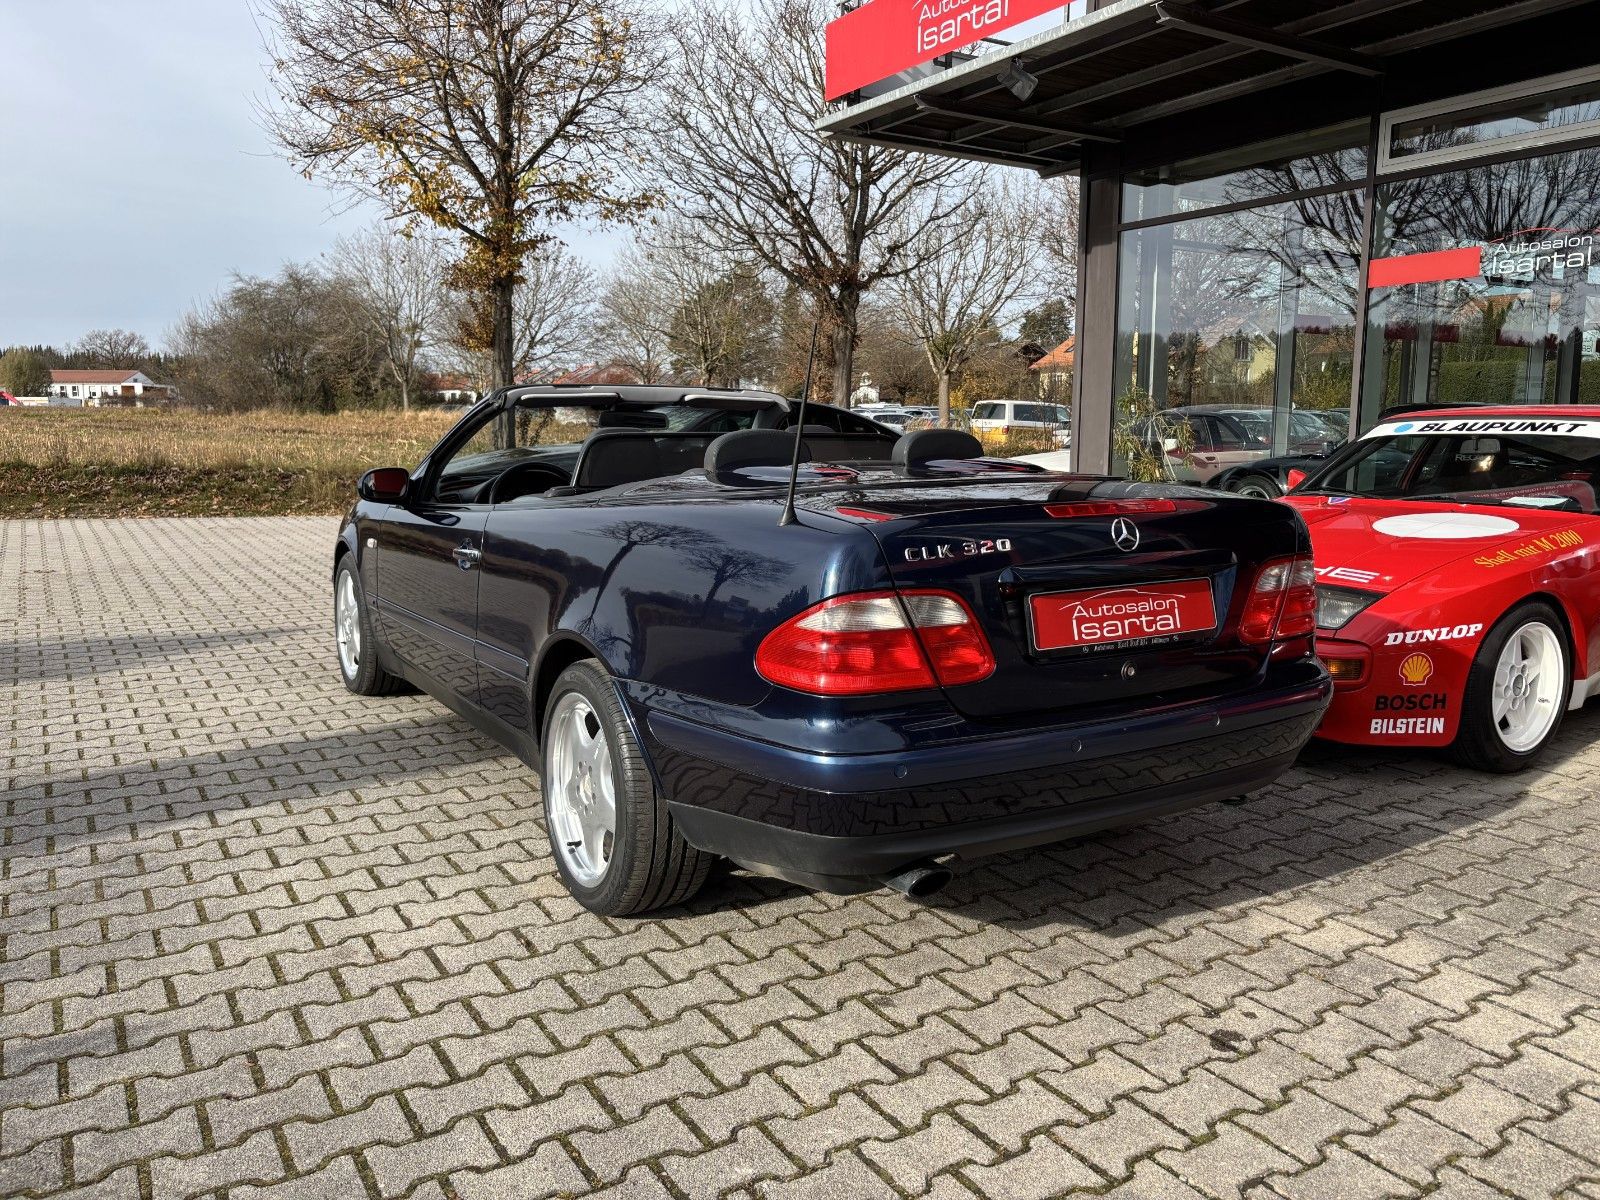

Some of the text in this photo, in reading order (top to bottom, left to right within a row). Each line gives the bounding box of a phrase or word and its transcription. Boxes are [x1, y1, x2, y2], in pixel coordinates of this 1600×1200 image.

[916, 0, 1009, 54] Isartal
[1494, 235, 1593, 255] Autosalon
[1491, 246, 1592, 275] Isartal
[1417, 421, 1588, 433] BLAUPUNKT
[904, 538, 1012, 562] CLK 320
[1473, 529, 1584, 568] Shell mit M 2000
[1072, 597, 1179, 619] Autosalon
[1072, 608, 1181, 641] Isartal
[1384, 623, 1483, 646] DUNLOP
[1374, 693, 1447, 711] BOSCH
[1370, 717, 1445, 734] BILSTEIN
